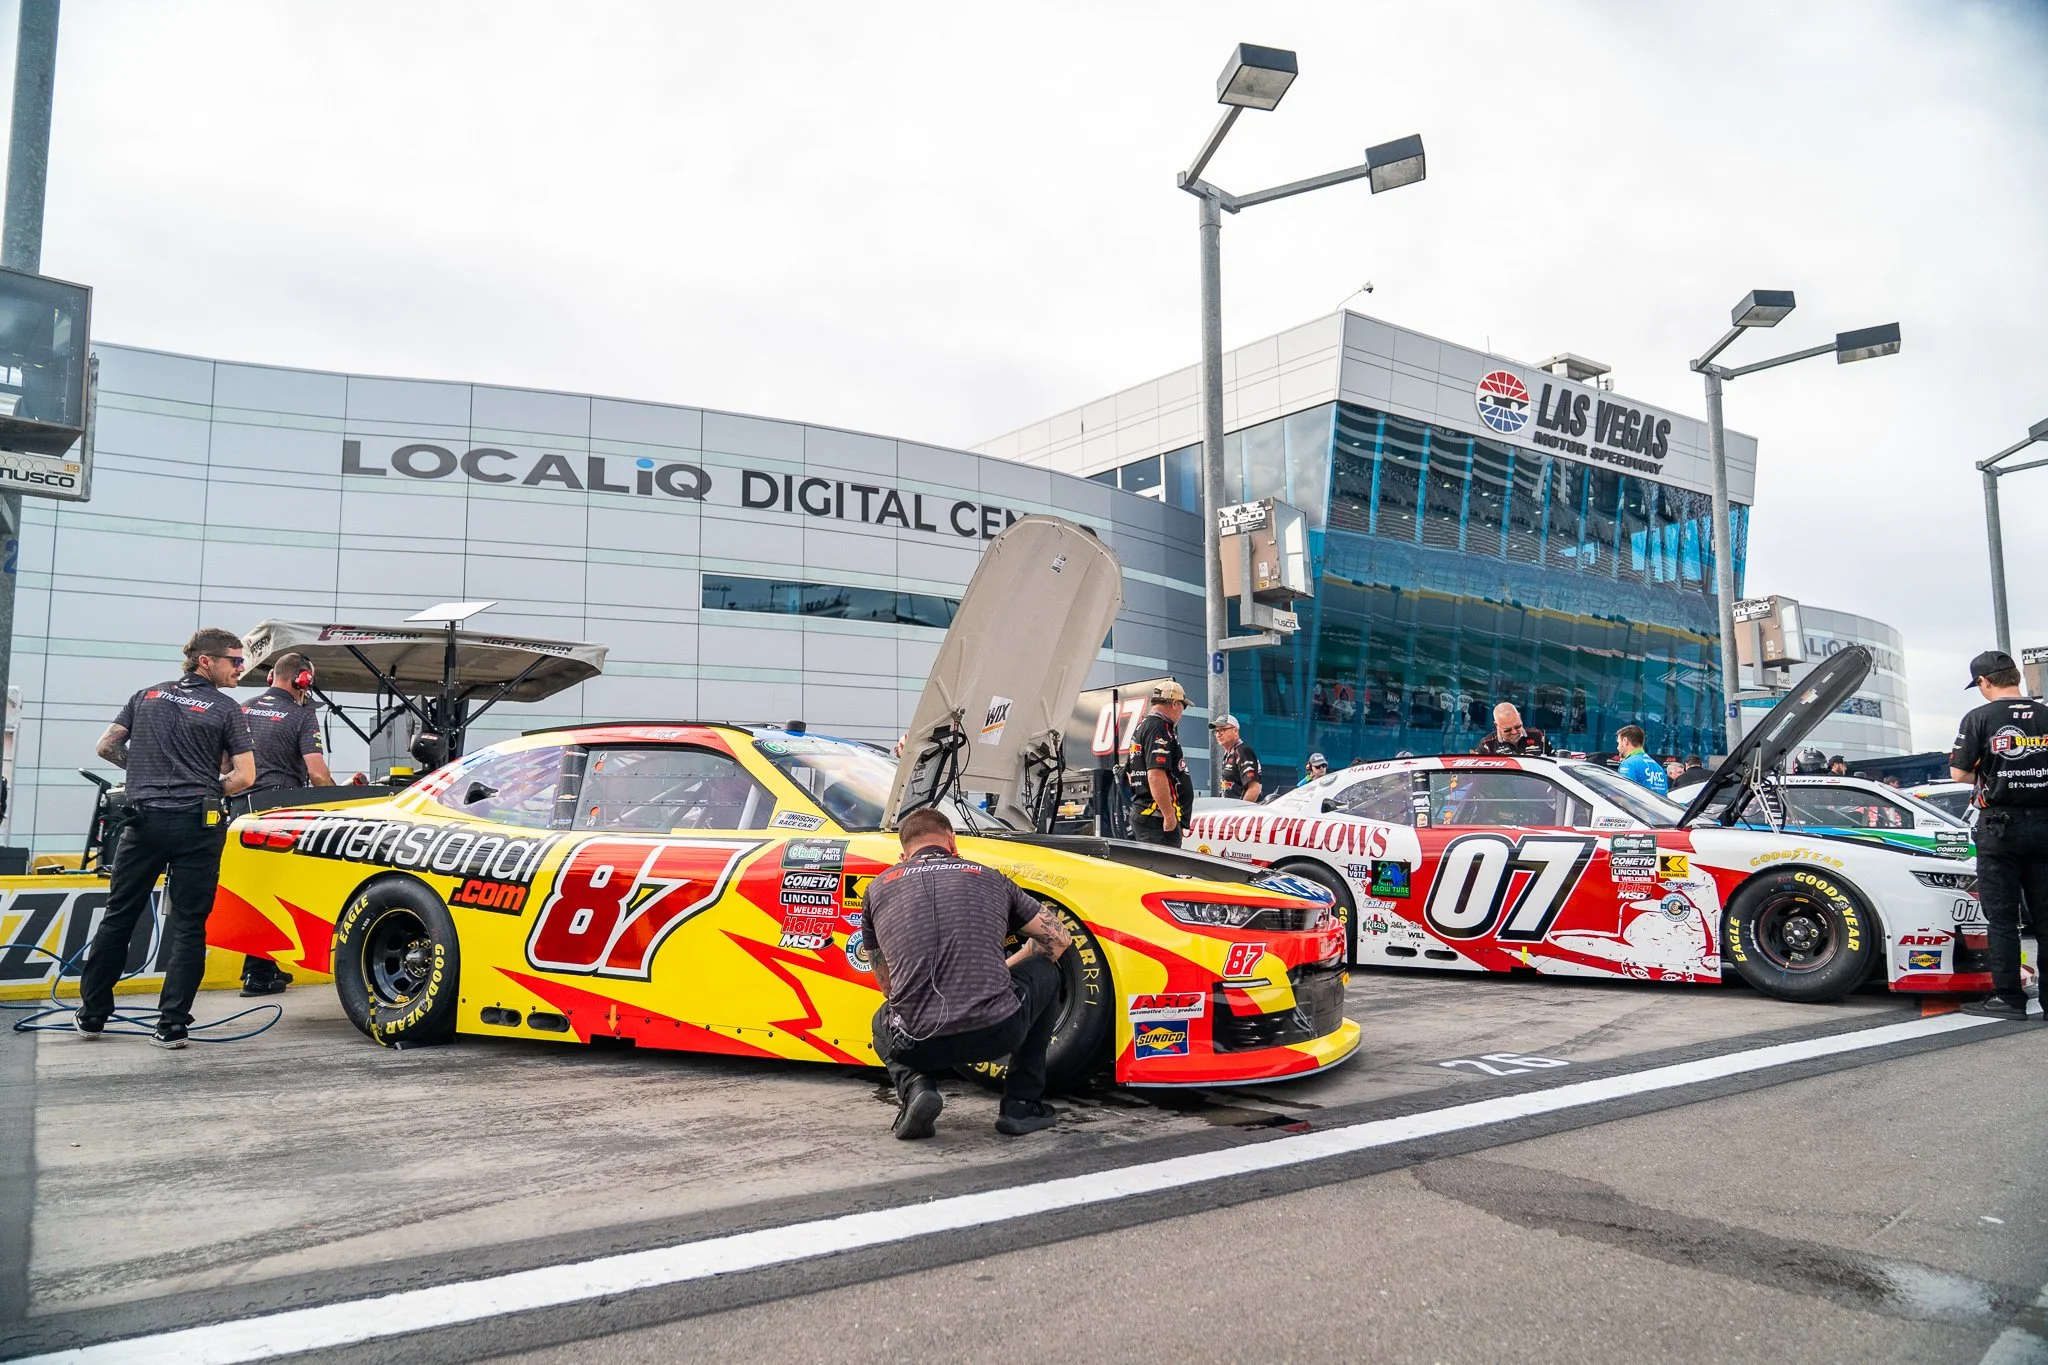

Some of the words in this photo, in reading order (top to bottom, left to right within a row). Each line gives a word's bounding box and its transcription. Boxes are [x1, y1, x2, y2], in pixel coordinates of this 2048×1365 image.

[1537, 383, 1590, 437] LAS
[1595, 400, 1671, 459] VEGAS
[1532, 431, 1588, 456] MOTOR
[1589, 447, 1663, 475] SPEEDWAY
[741, 469, 937, 533] DIGITAL
[1274, 617, 1296, 630] musco
[1207, 651, 1225, 675] 6
[985, 702, 1011, 727] WIX
[2021, 711, 2034, 719] 07
[1091, 696, 1148, 756] 07
[1996, 739, 2008, 749] SS
[785, 812, 819, 823] NASCAR
[1181, 814, 1265, 844] OWBOY
[1266, 816, 1391, 859] PILLOWS
[1611, 856, 1656, 866] COMETIC
[1750, 848, 1844, 868] GOODYEAR
[784, 874, 839, 889] COMETIC
[1349, 871, 1366, 879] VOTE
[454, 880, 527, 911] .com
[783, 893, 830, 905] LINCOLN
[1425, 834, 1598, 943] 07
[1617, 883, 1652, 894] Holley
[1617, 892, 1648, 900] MSD
[527, 837, 768, 981] 87
[793, 906, 834, 916] WELDERS
[1364, 900, 1397, 909] GARAGE
[1794, 871, 1860, 951] GOODYEAR
[1951, 898, 1981, 923] 07
[339, 895, 369, 944] EAGLE
[781, 916, 834, 940] Holley
[779, 934, 826, 950] MSD
[1729, 916, 1748, 963] EAGLE
[1900, 935, 1951, 946] ARP
[1222, 942, 1267, 978] 87
[1910, 956, 1940, 965] SUNOCO
[385, 943, 445, 1035] GOODYEAR
[1130, 994, 1202, 1011] ARP
[1137, 1032, 1184, 1045] SUNOCO
[1439, 1053, 1571, 1077] 26
